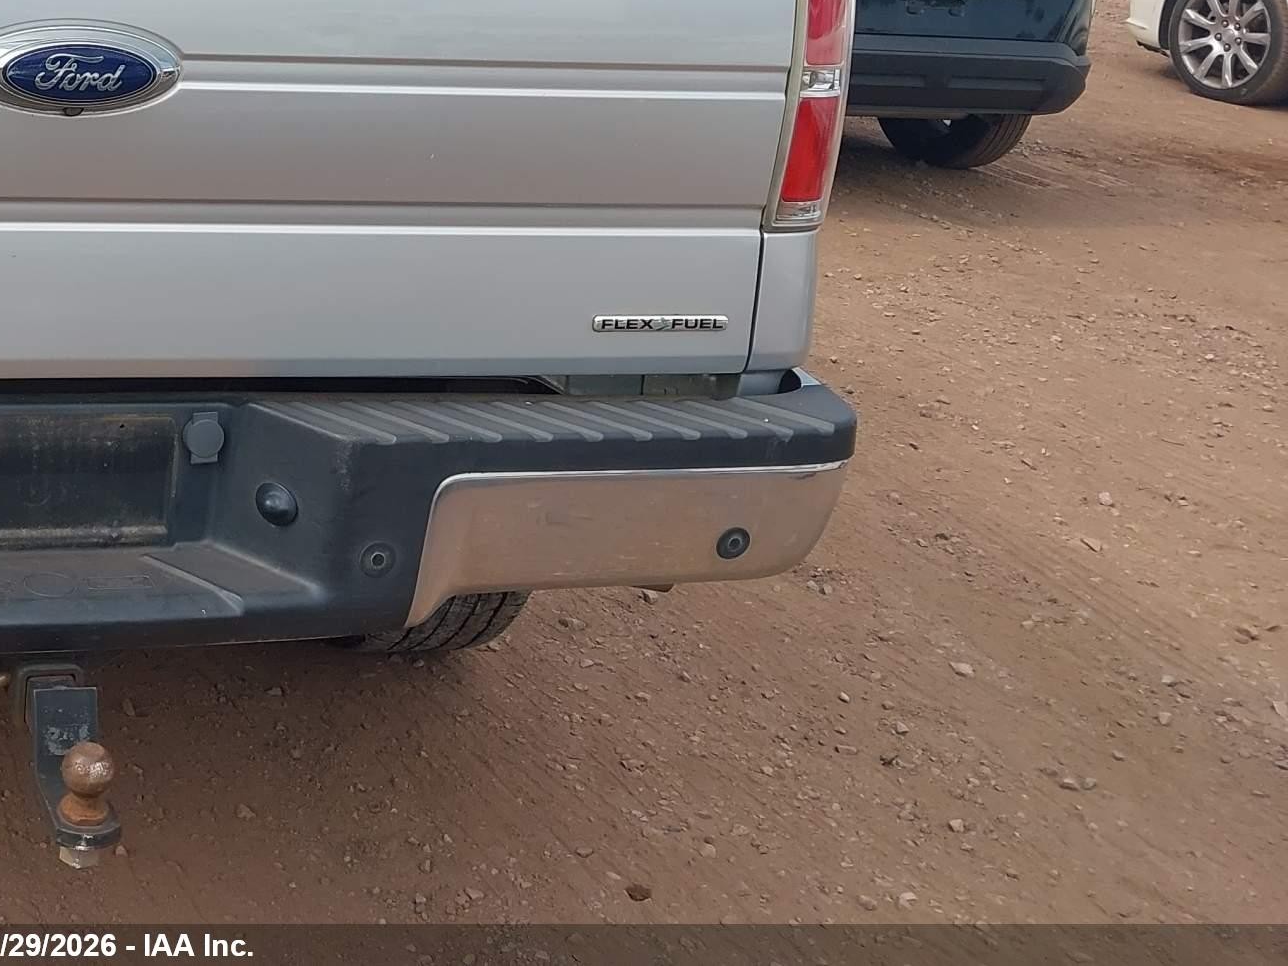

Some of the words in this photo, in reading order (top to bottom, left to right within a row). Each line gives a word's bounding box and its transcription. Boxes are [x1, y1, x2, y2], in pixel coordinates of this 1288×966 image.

[34, 53, 124, 92] Ford
[601, 319, 654, 330] FLEX
[671, 318, 724, 330] FUEL
